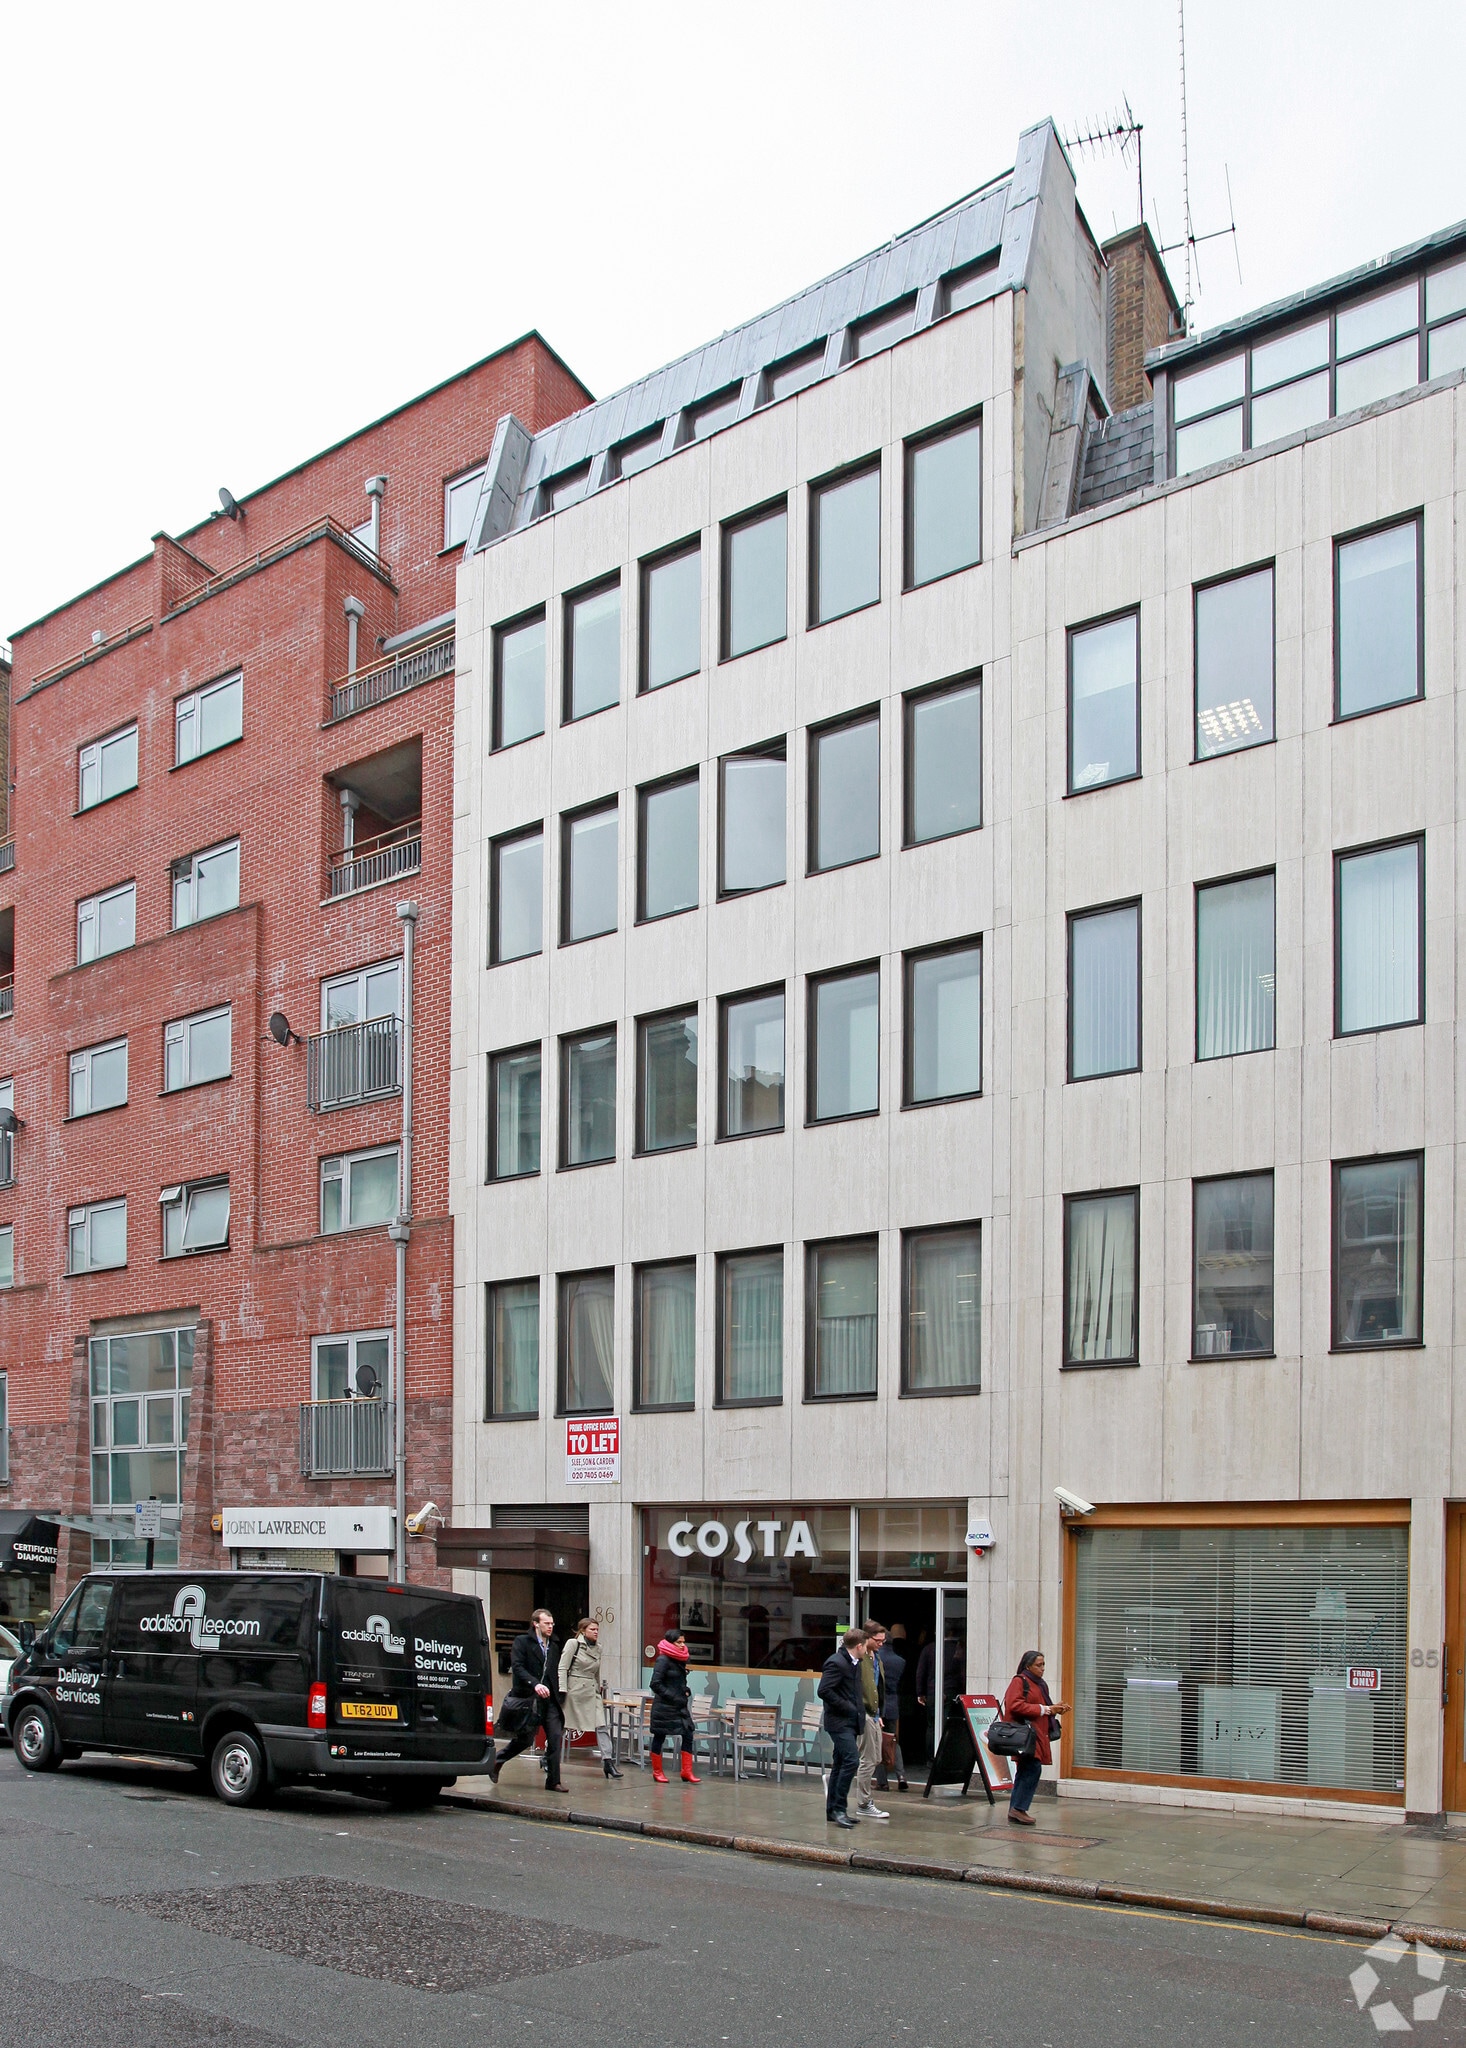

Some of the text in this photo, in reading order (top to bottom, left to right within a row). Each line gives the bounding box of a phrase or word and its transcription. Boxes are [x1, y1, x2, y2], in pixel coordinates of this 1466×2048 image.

[569, 1421, 617, 1432] PRIME OFFICE FLOORS
[569, 1433, 617, 1453] TO LET
[572, 1470, 613, 1479] 020 7405 0469
[225, 1520, 256, 1535] JOHN
[258, 1520, 326, 1535] LAWRENCE
[13, 1543, 58, 1555] CERTIFICATE
[667, 1520, 818, 1564] COSTA
[594, 1606, 615, 1624] 86
[390, 1633, 406, 1646] lee
[414, 1637, 463, 1659] Delivery
[414, 1655, 468, 1673] Services
[1410, 1648, 1439, 1668] 85
[57, 1667, 99, 1688] Delivery
[343, 1670, 376, 1679] TRANSIT
[1352, 1669, 1375, 1679] TRADE
[1352, 1677, 1375, 1688] ONLY
[55, 1686, 101, 1705] Services
[972, 1698, 988, 1706] COSTA
[346, 1704, 393, 1717] LT62 UOV
